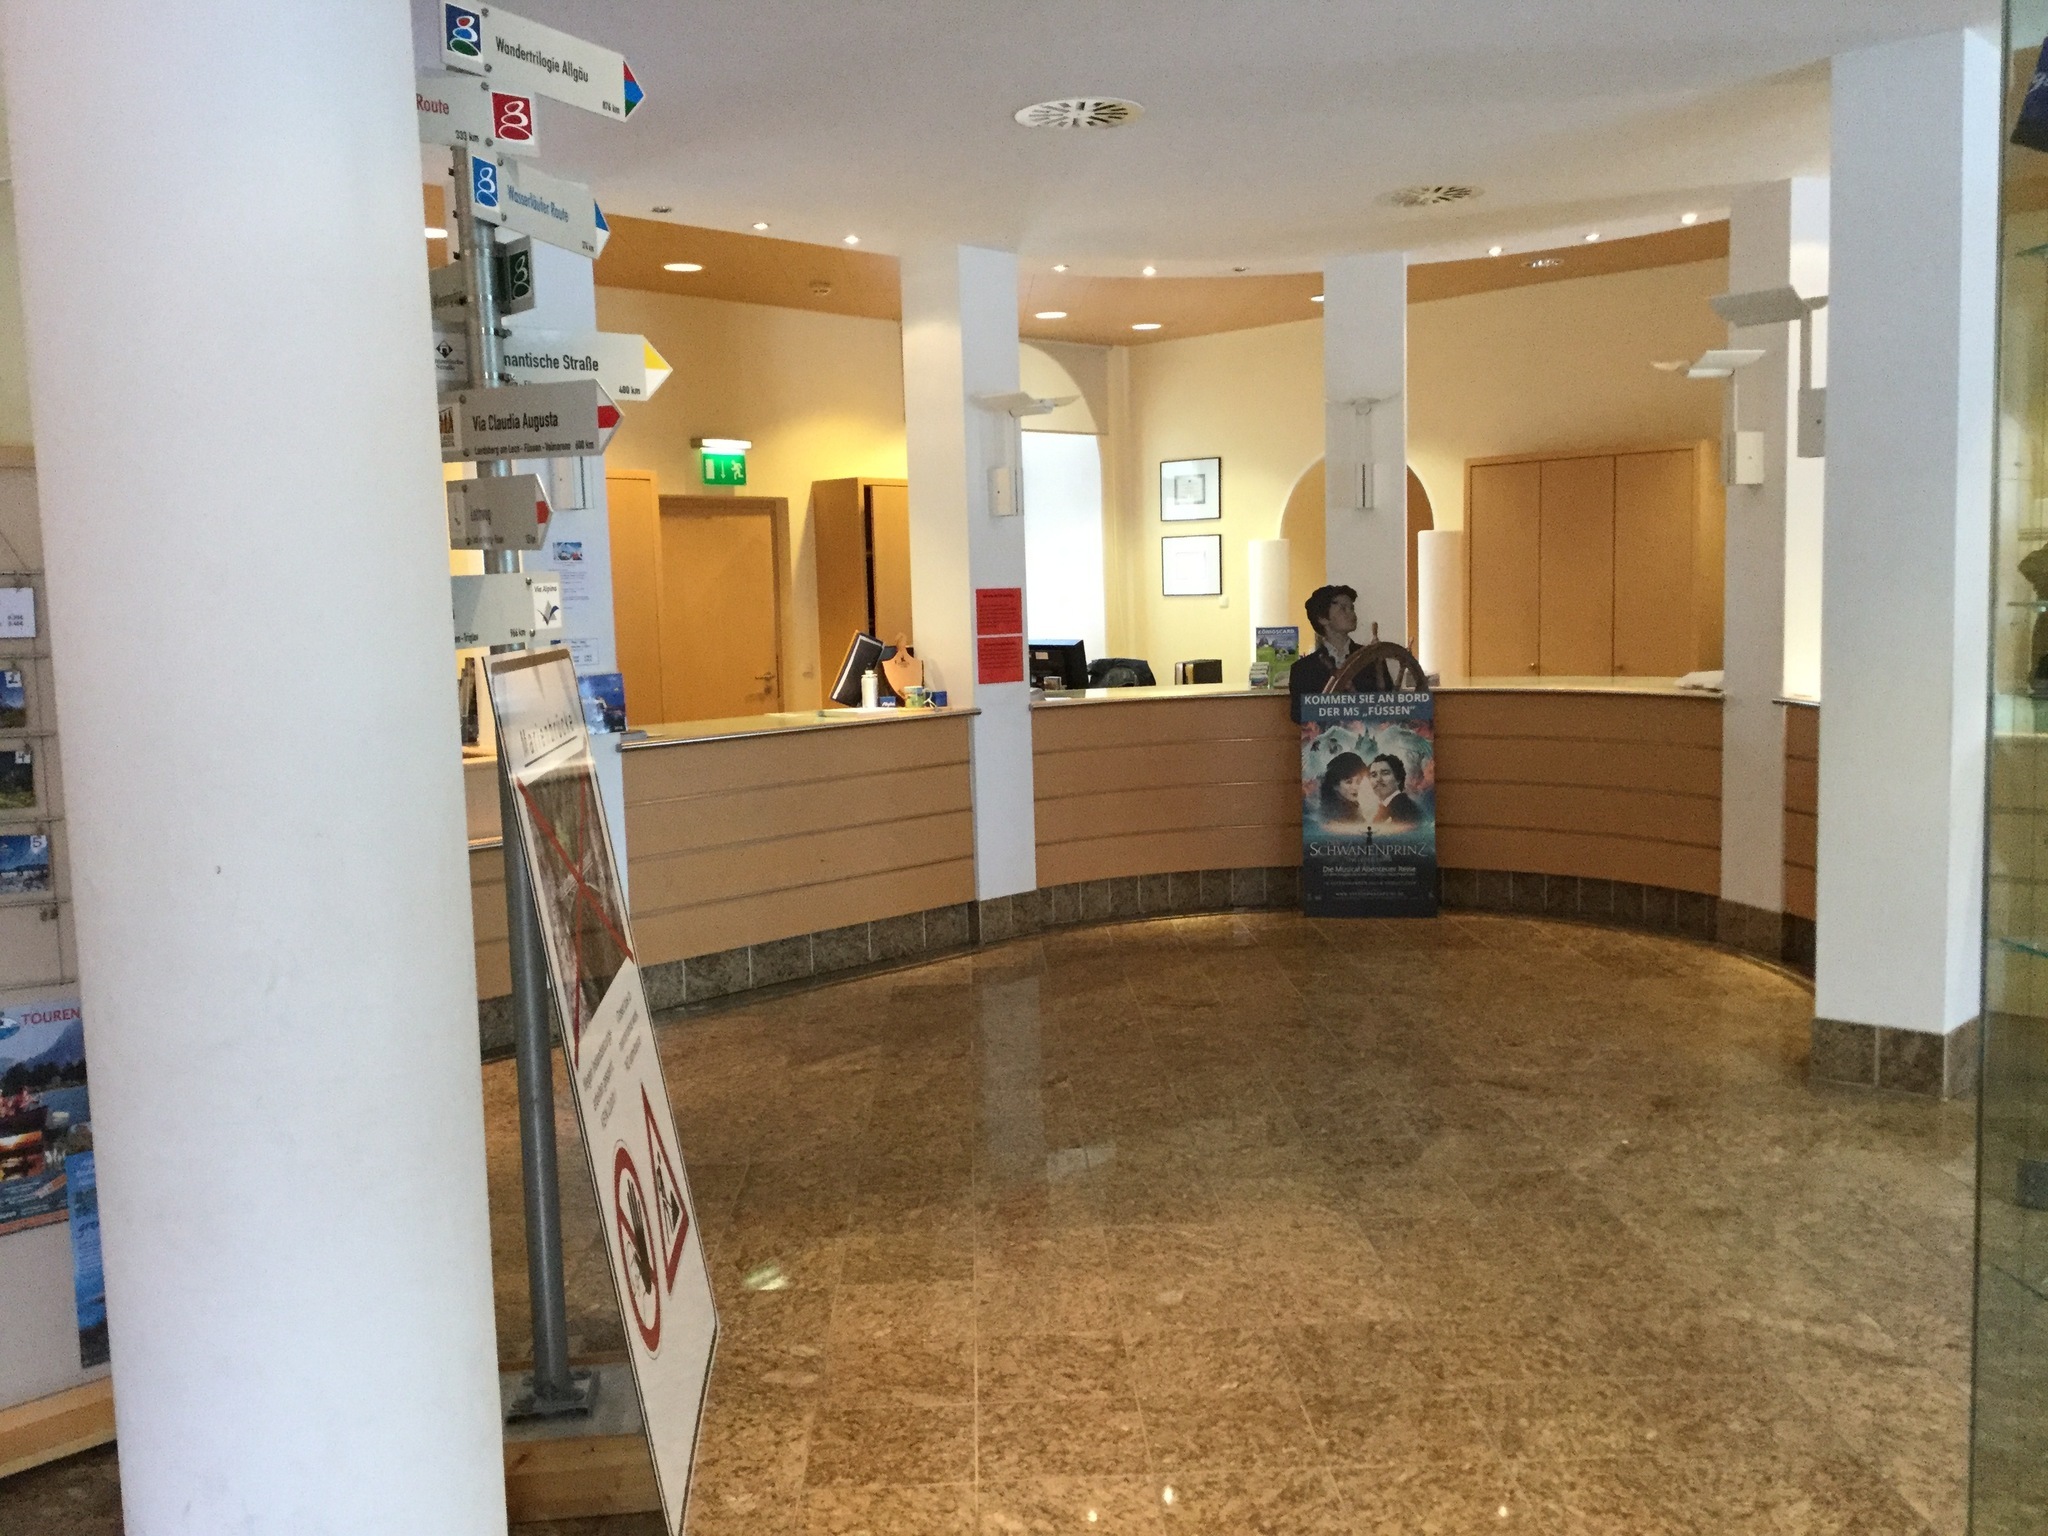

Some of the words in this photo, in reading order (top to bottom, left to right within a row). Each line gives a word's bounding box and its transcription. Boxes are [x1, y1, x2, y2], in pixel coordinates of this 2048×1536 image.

[495, 36, 560, 73] Wandertrilogie
[562, 60, 589, 82] Allgäu
[416, 93, 450, 115] Route
[468, 132, 480, 142] km
[563, 354, 599, 373] Straße
[631, 386, 641, 395] km
[472, 415, 487, 431] Via
[488, 413, 520, 431] Claudia
[522, 411, 559, 432] Augusta
[584, 440, 595, 449] km
[1304, 695, 1356, 705] KOMMEN
[1359, 694, 1375, 704] SIE
[1377, 694, 1395, 703] AN
[1397, 693, 1430, 703] BORD
[1318, 707, 1340, 717] DER
[1343, 707, 1360, 716] MS
[1322, 865, 1335, 873] Die
[1335, 865, 1360, 873] Musical
[21, 1007, 82, 1026] TOUREN
